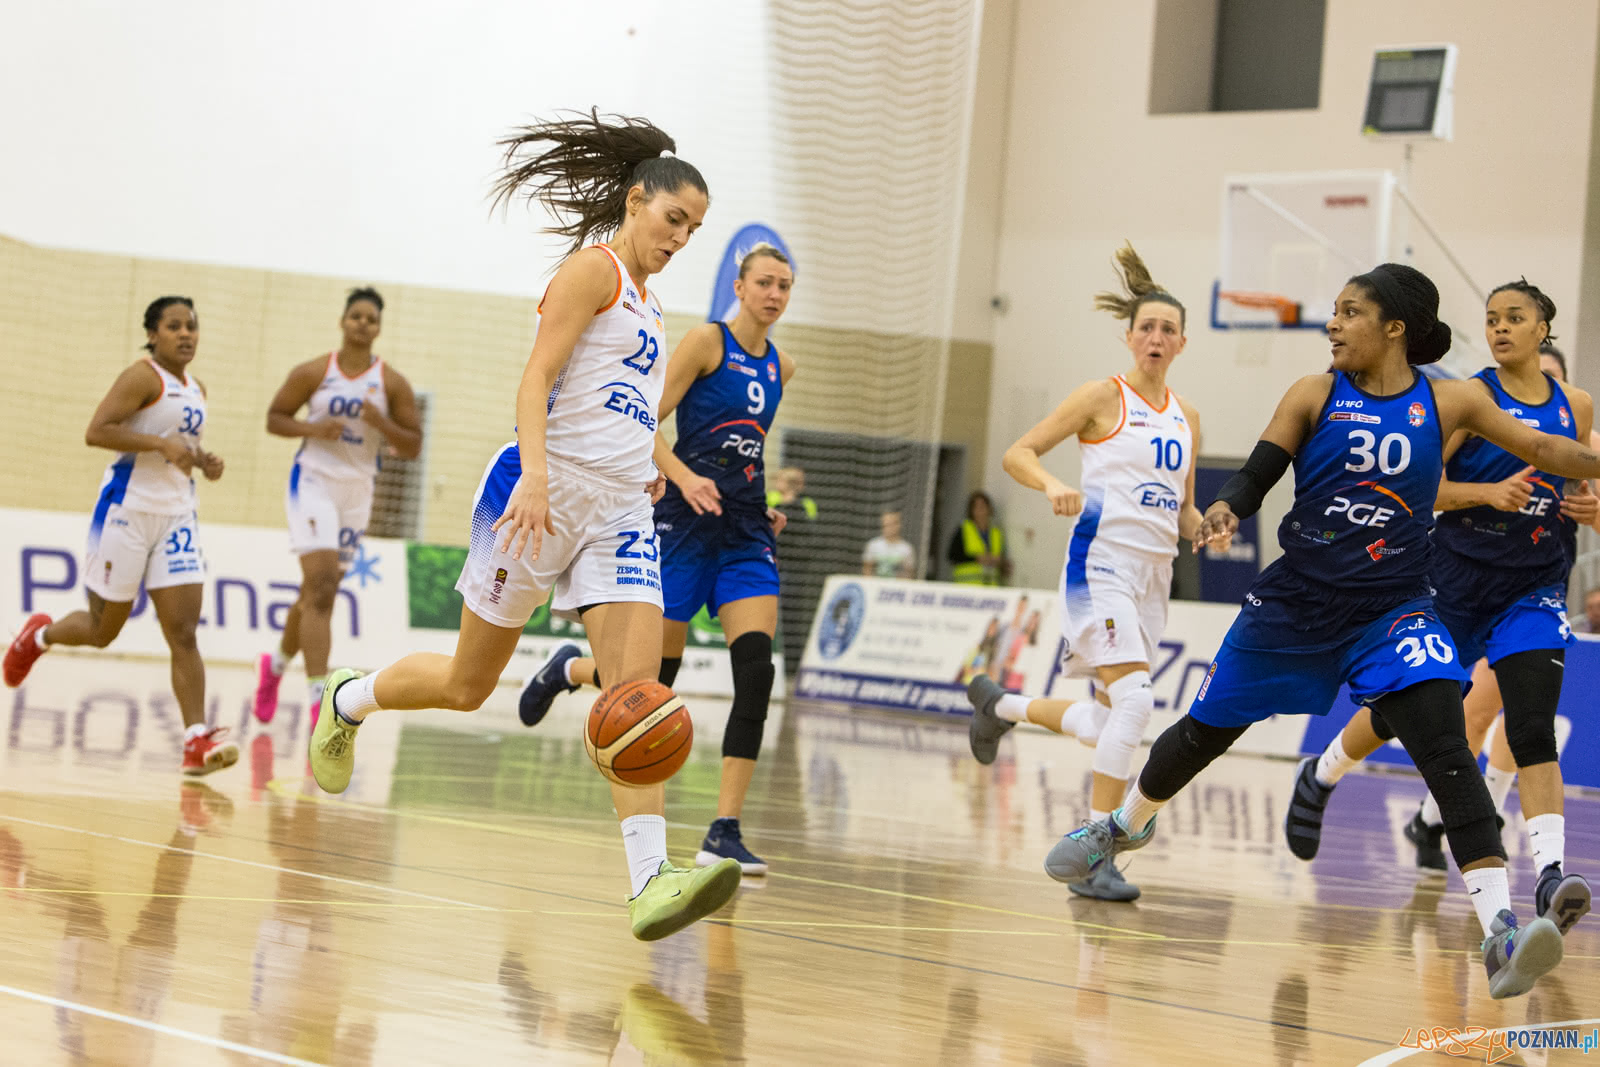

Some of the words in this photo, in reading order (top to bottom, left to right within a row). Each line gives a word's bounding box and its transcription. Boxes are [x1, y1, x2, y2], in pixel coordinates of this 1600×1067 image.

[622, 328, 659, 376] 23
[746, 381, 766, 415] 9
[178, 406, 204, 437] 32
[721, 433, 762, 459] PGE
[1150, 437, 1183, 472] 10
[1344, 429, 1412, 476] 30
[1324, 496, 1396, 529] PGE
[1518, 496, 1553, 517] GE
[166, 527, 195, 556] 32
[615, 530, 659, 563] 23
[1395, 633, 1454, 668] 30
[623, 690, 647, 710] FIBA
